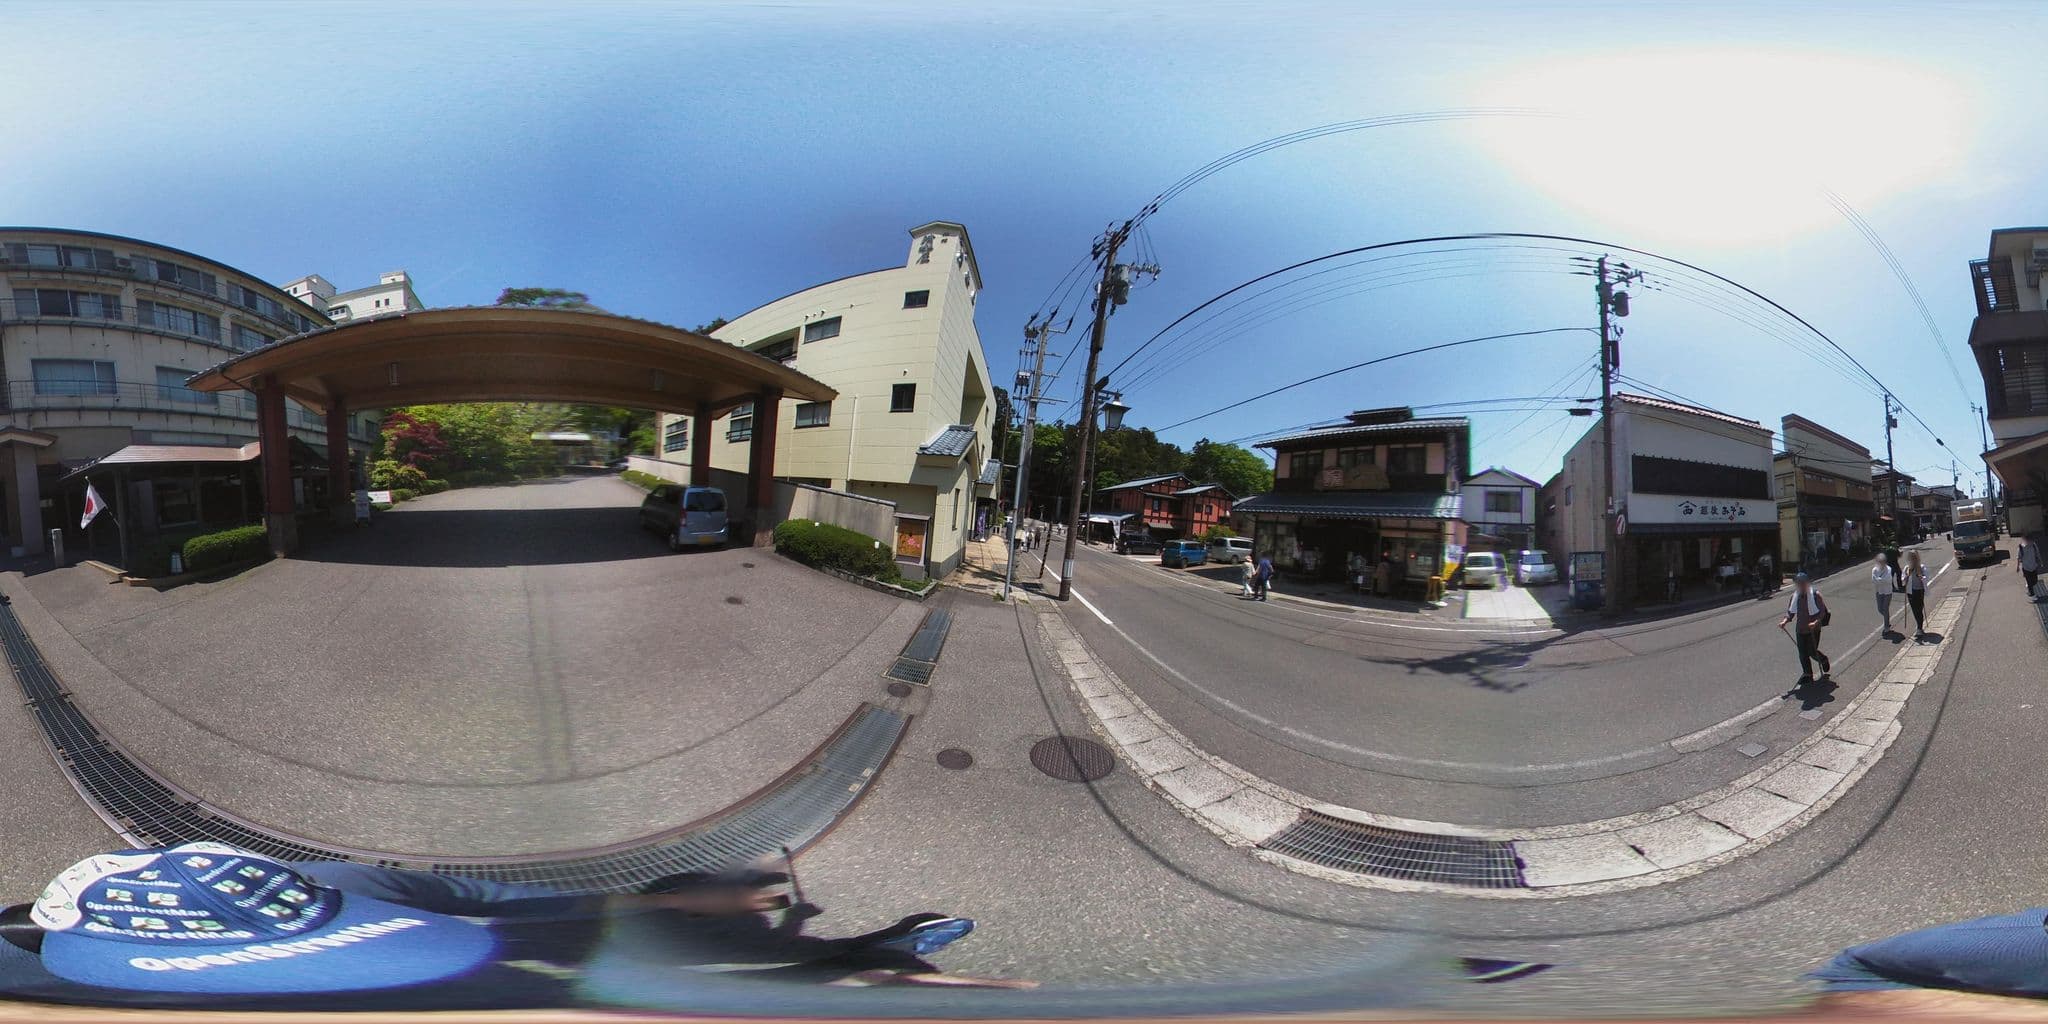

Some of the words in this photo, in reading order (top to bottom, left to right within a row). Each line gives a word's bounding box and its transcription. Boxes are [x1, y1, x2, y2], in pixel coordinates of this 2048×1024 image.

[85, 901, 211, 917] OpenStreetMap
[84, 921, 255, 940] OpenStreetMap
[128, 916, 430, 972] OpenStreetMap
